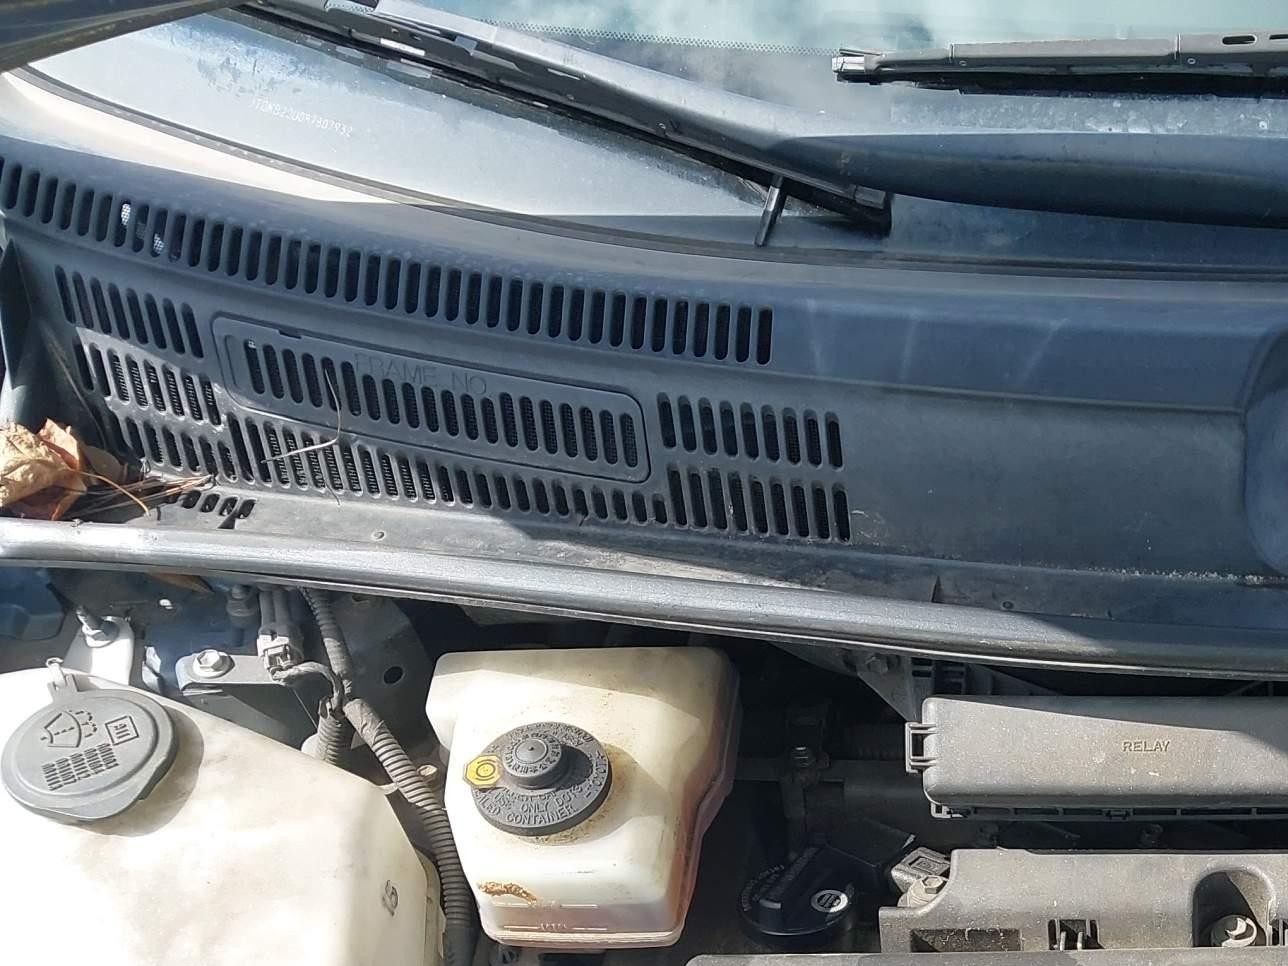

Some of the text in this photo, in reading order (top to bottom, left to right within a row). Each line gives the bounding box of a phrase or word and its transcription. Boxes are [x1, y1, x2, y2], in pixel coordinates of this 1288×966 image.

[353, 353, 438, 385] FRAME
[1122, 740, 1170, 752] RELAY
[521, 802, 549, 813] ONLY
